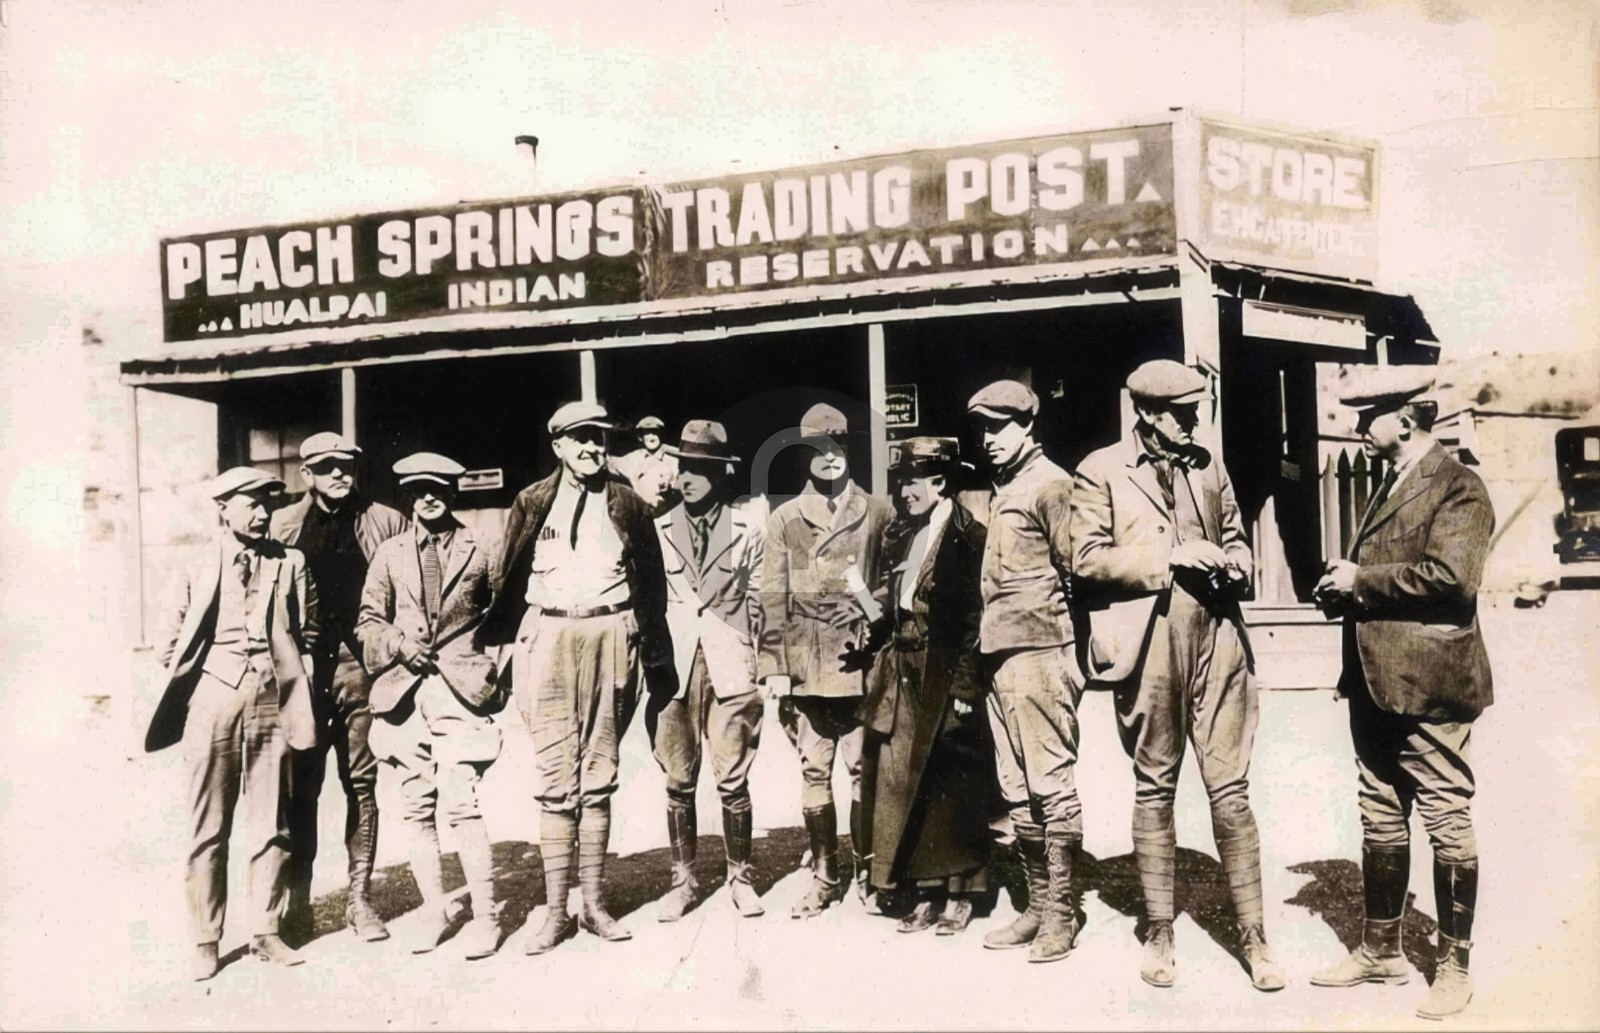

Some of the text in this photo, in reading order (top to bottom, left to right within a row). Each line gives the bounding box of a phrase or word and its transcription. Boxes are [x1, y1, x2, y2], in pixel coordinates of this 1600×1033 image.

[1207, 136, 1366, 205] STORE
[167, 225, 354, 300] PEACH
[377, 196, 635, 278] SPRINGS
[661, 165, 911, 253] TRADING
[448, 272, 586, 310] INDIAN
[706, 224, 1068, 289] RESERVATION
